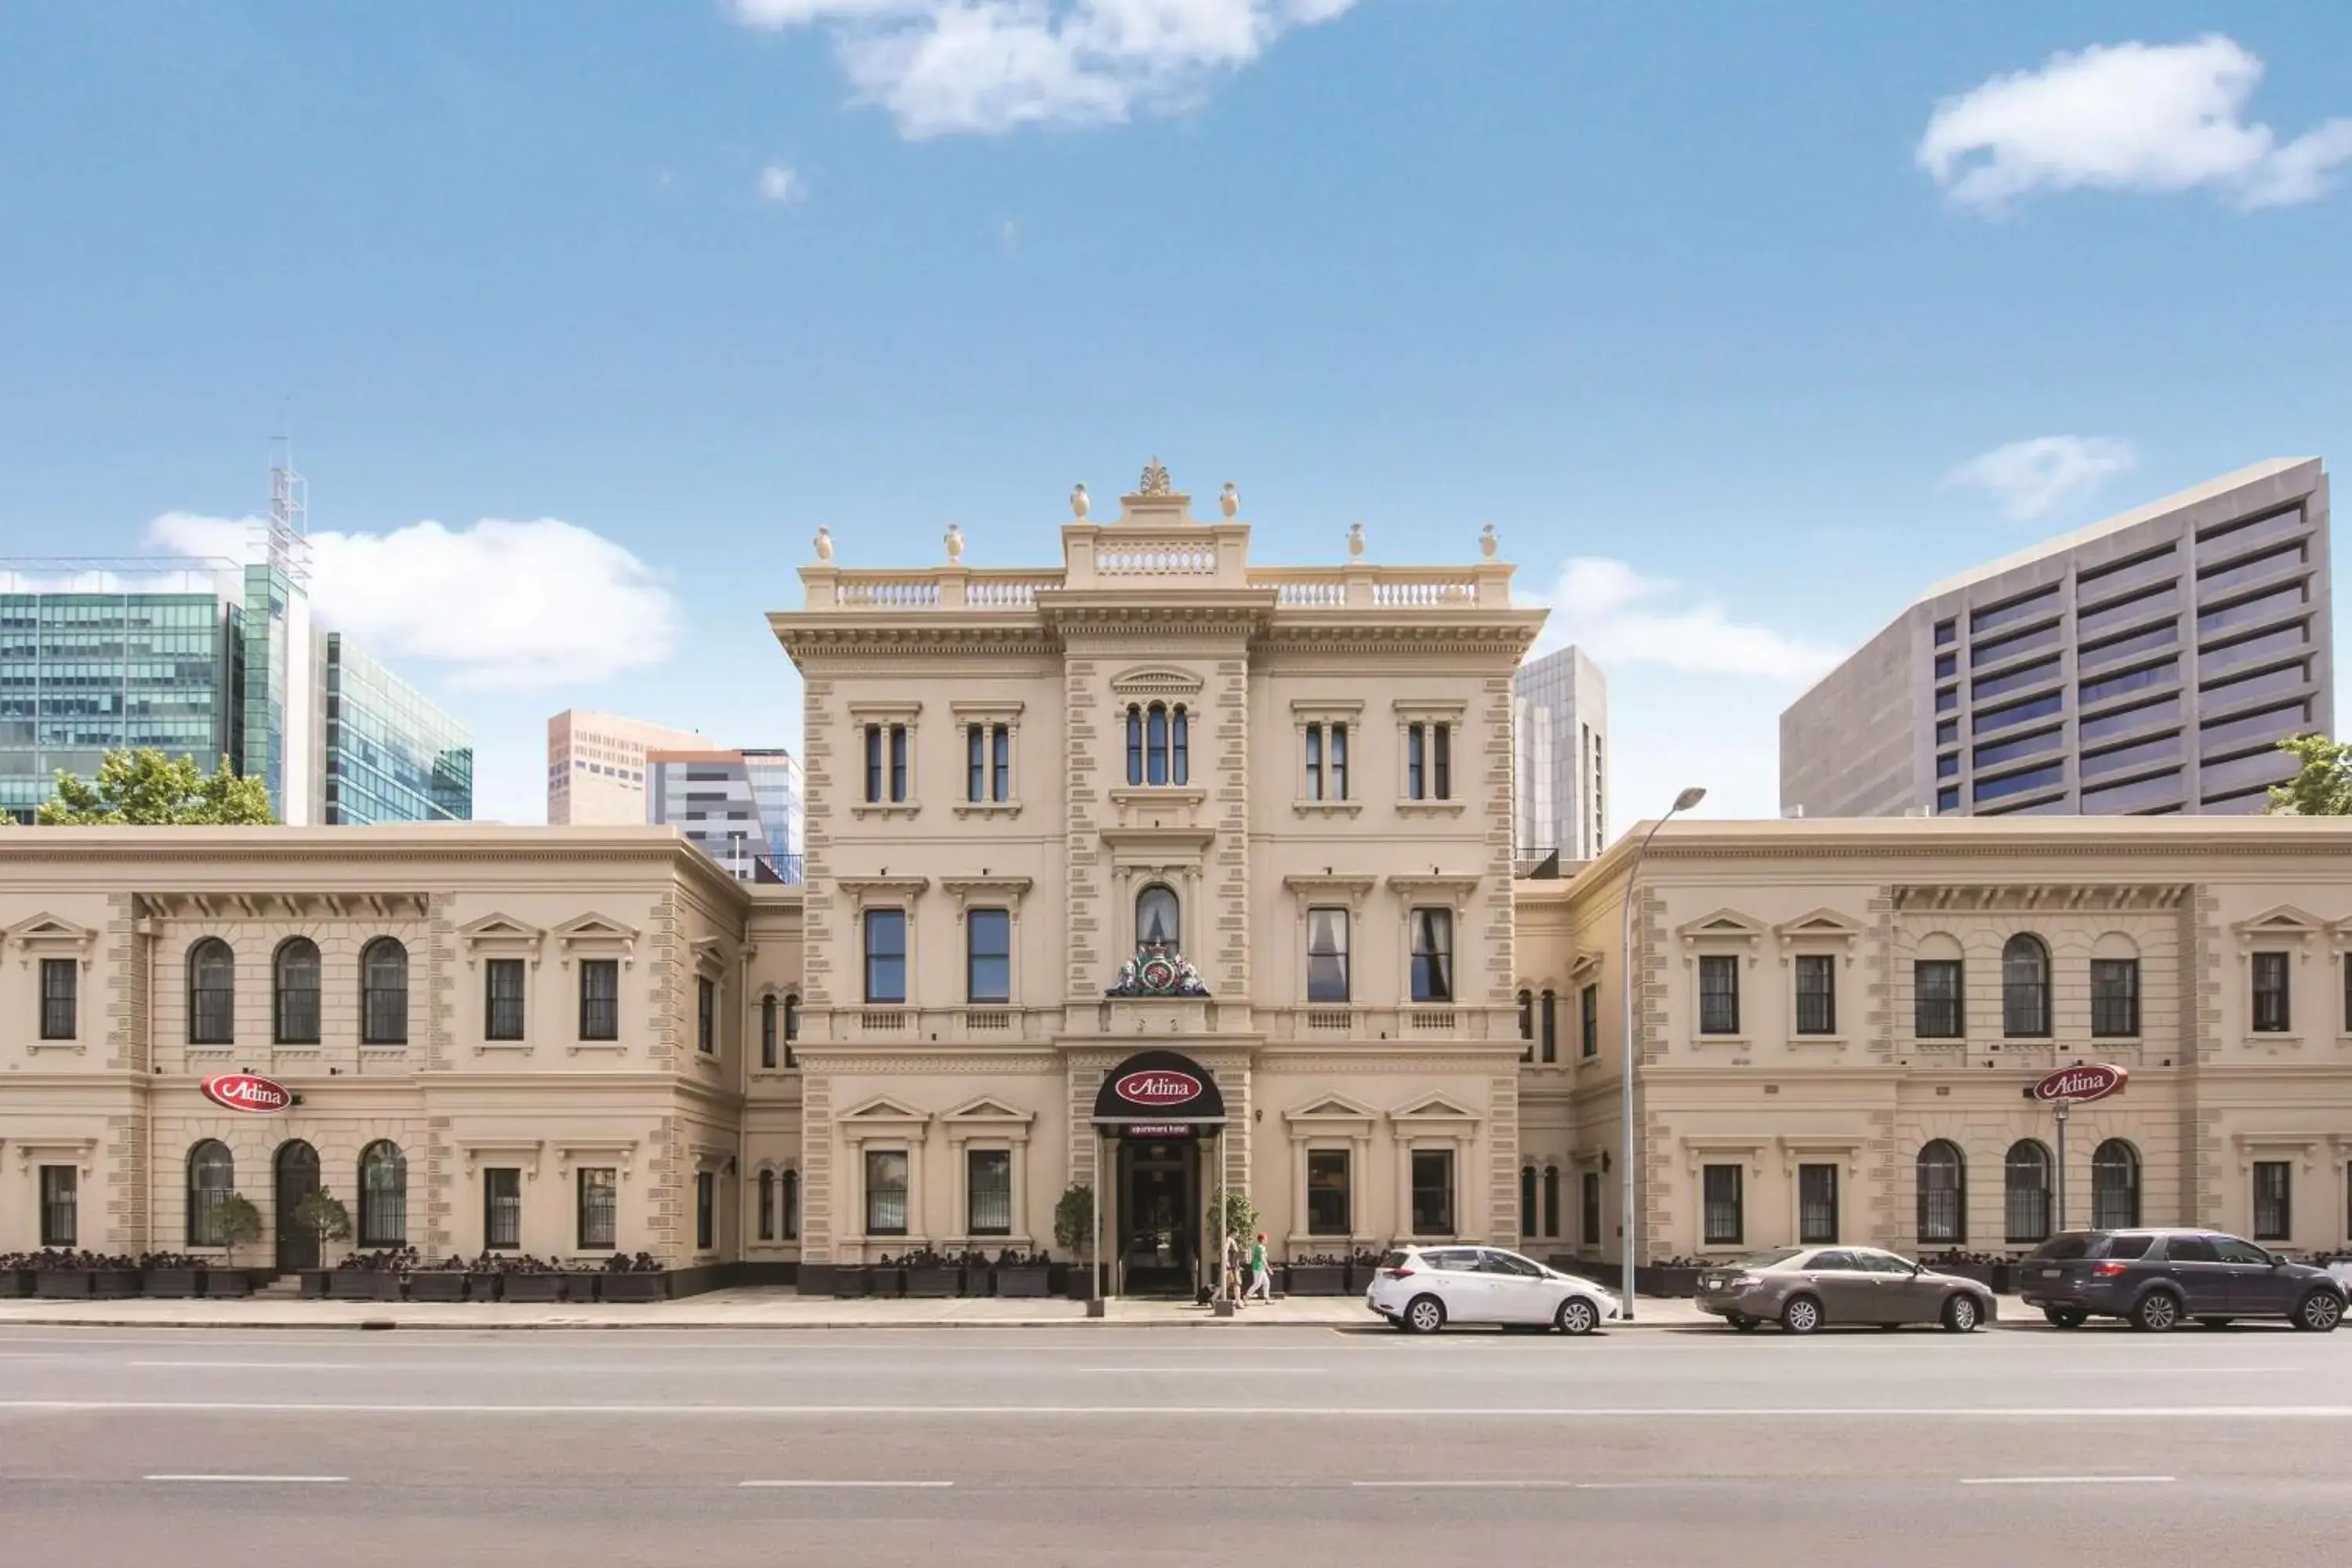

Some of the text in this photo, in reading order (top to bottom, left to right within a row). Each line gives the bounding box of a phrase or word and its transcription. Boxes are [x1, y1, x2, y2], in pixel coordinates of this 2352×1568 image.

[223, 1082, 281, 1104] Adina
[1128, 1078, 1189, 1095] Adina
[2044, 1073, 2104, 1096] Adina
